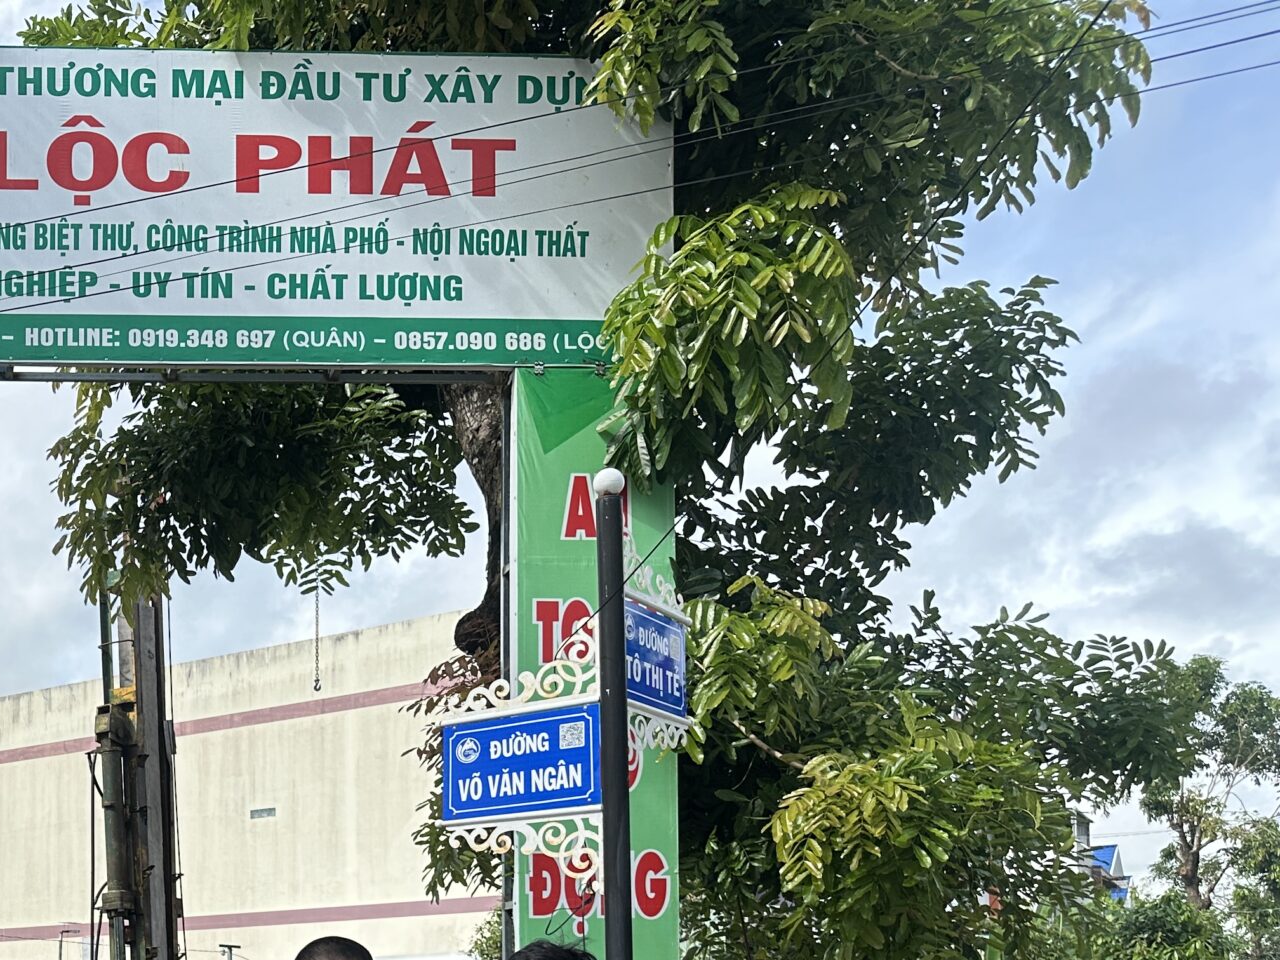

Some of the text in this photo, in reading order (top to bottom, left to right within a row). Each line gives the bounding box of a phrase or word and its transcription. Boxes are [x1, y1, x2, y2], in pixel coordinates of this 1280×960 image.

[172, 69, 244, 106] MẠI
[259, 58, 341, 101] ĐẦU
[355, 67, 412, 102] TƯ
[423, 66, 503, 103] XÂY
[235, 120, 517, 197] PHÁT
[34, 217, 83, 257] BIỆT
[89, 220, 139, 257] THỰ,
[146, 218, 209, 253] CÔNG
[215, 219, 282, 254] TRÌNH
[289, 219, 337, 254] NHÀ
[343, 217, 390, 255] PHỐ
[412, 222, 451, 262] NỘI
[459, 227, 528, 262] NGOẠI
[534, 220, 590, 258] THẤT
[131, 271, 173, 298] UY
[181, 266, 234, 299] TÍN
[266, 264, 348, 300] CHẤT
[358, 271, 464, 307] LƯỢNG
[24, 327, 121, 348] HOTLINE:
[128, 328, 228, 349] 0919.348
[235, 329, 276, 349] 697
[282, 326, 366, 352] (QUÂN)
[393, 331, 497, 351] 0857.090
[504, 332, 546, 351] 686
[639, 626, 669, 657] ĐƯỜNG
[625, 652, 642, 683] TÔ
[643, 661, 664, 697] THỊ
[489, 731, 550, 760] ĐƯỜNG
[458, 759, 583, 802] VÕ VĂN NGÂN
